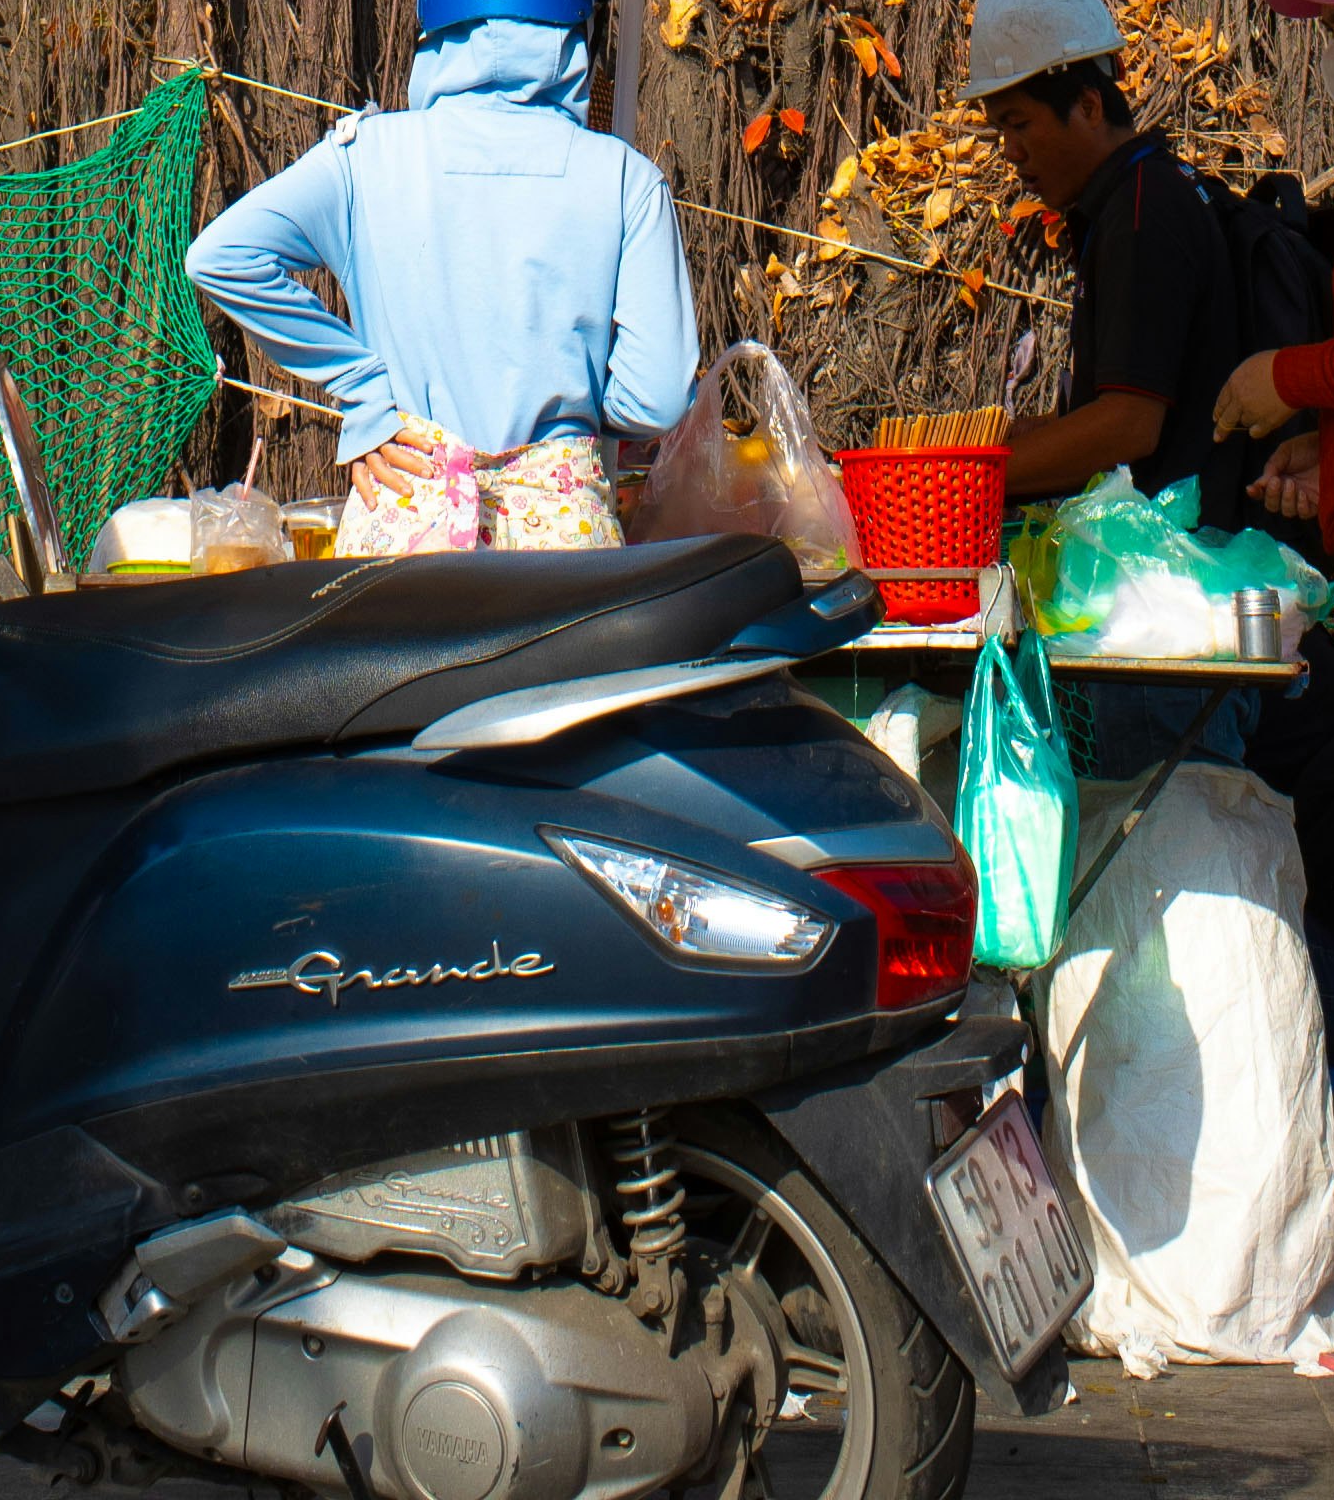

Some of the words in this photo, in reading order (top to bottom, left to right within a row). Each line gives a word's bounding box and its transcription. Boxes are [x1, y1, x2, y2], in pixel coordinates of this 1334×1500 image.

[288, 939, 555, 1008] Grande
[379, 1170, 511, 1210] Grande
[982, 1202, 1081, 1360] 201.40
[416, 1426, 489, 1467] YAMAHA
